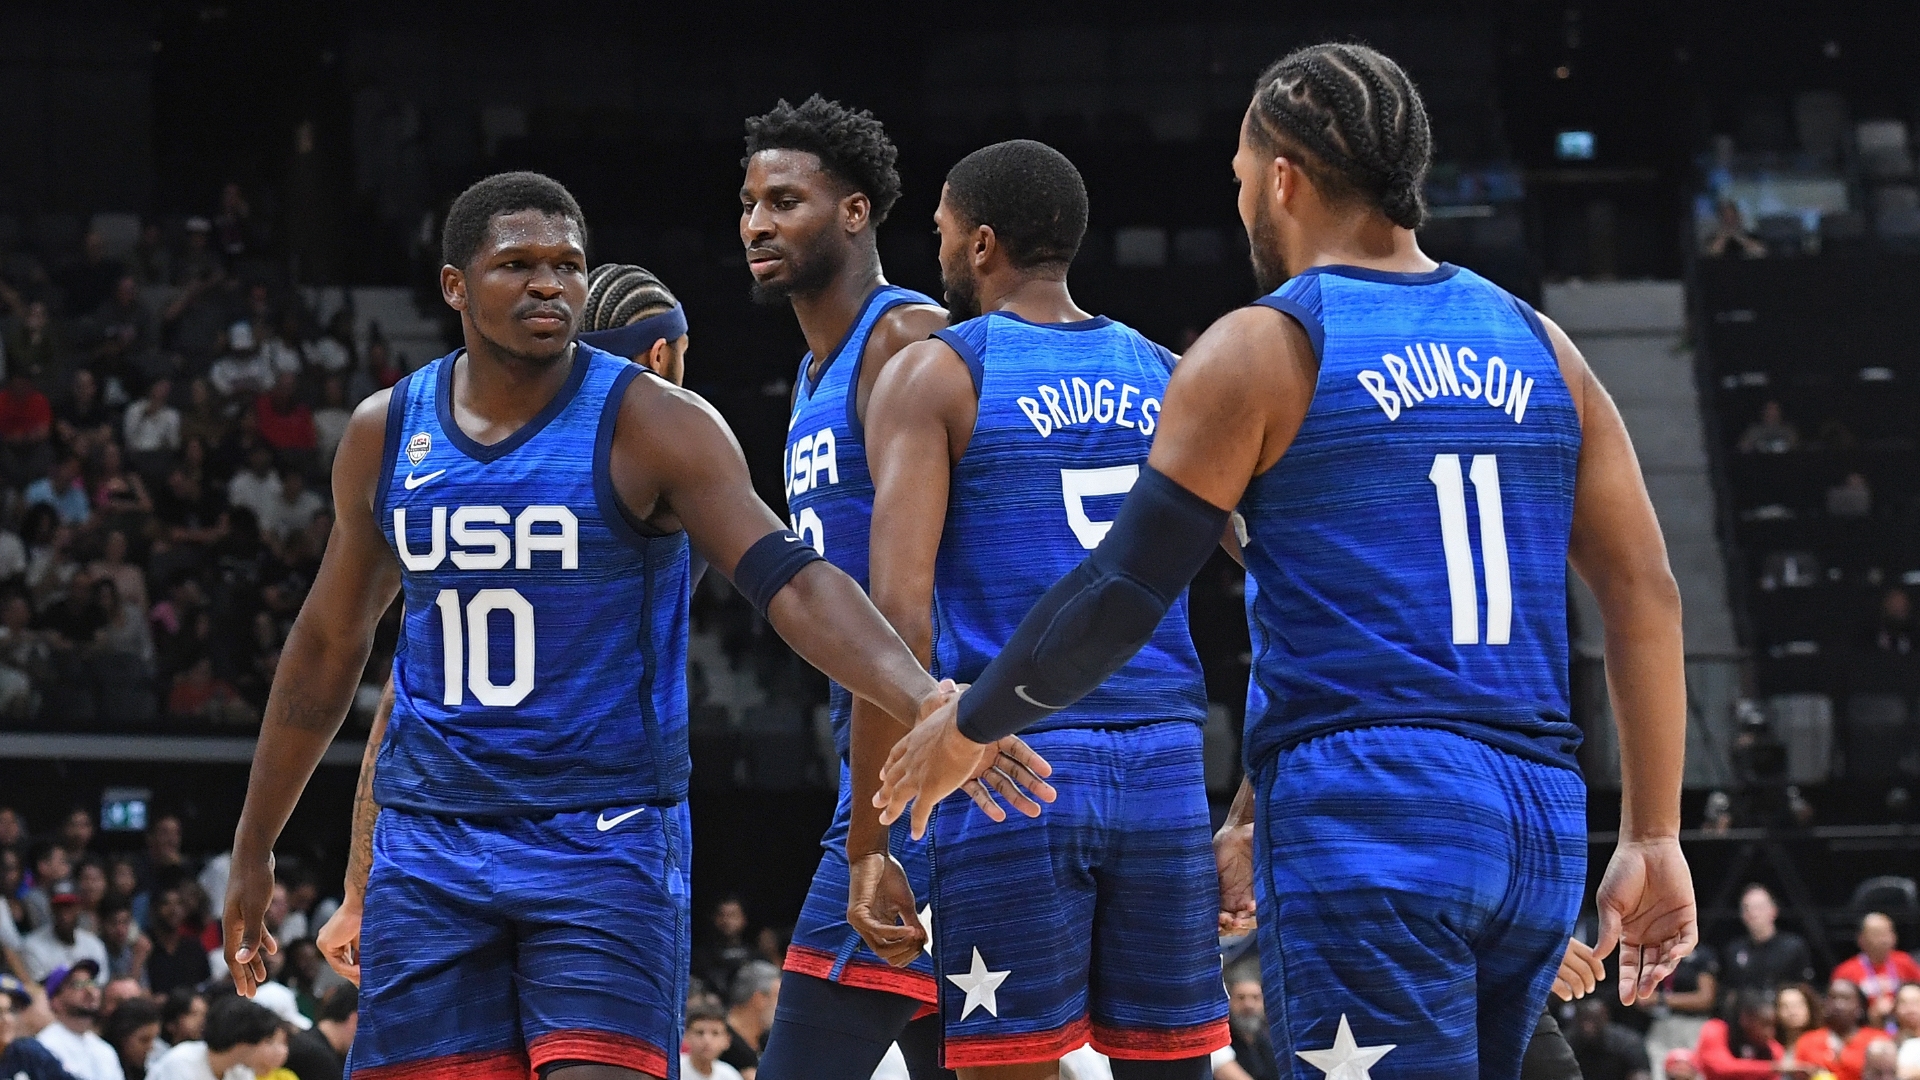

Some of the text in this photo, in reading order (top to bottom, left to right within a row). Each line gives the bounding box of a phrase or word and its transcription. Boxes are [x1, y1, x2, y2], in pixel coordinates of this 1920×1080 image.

[1017, 377, 1161, 438] BRIDGES
[1357, 343, 1534, 424] BRUNSON
[784, 427, 839, 500] USA
[394, 505, 578, 571] USA
[1428, 454, 1512, 644] 11
[436, 588, 535, 706] 10
